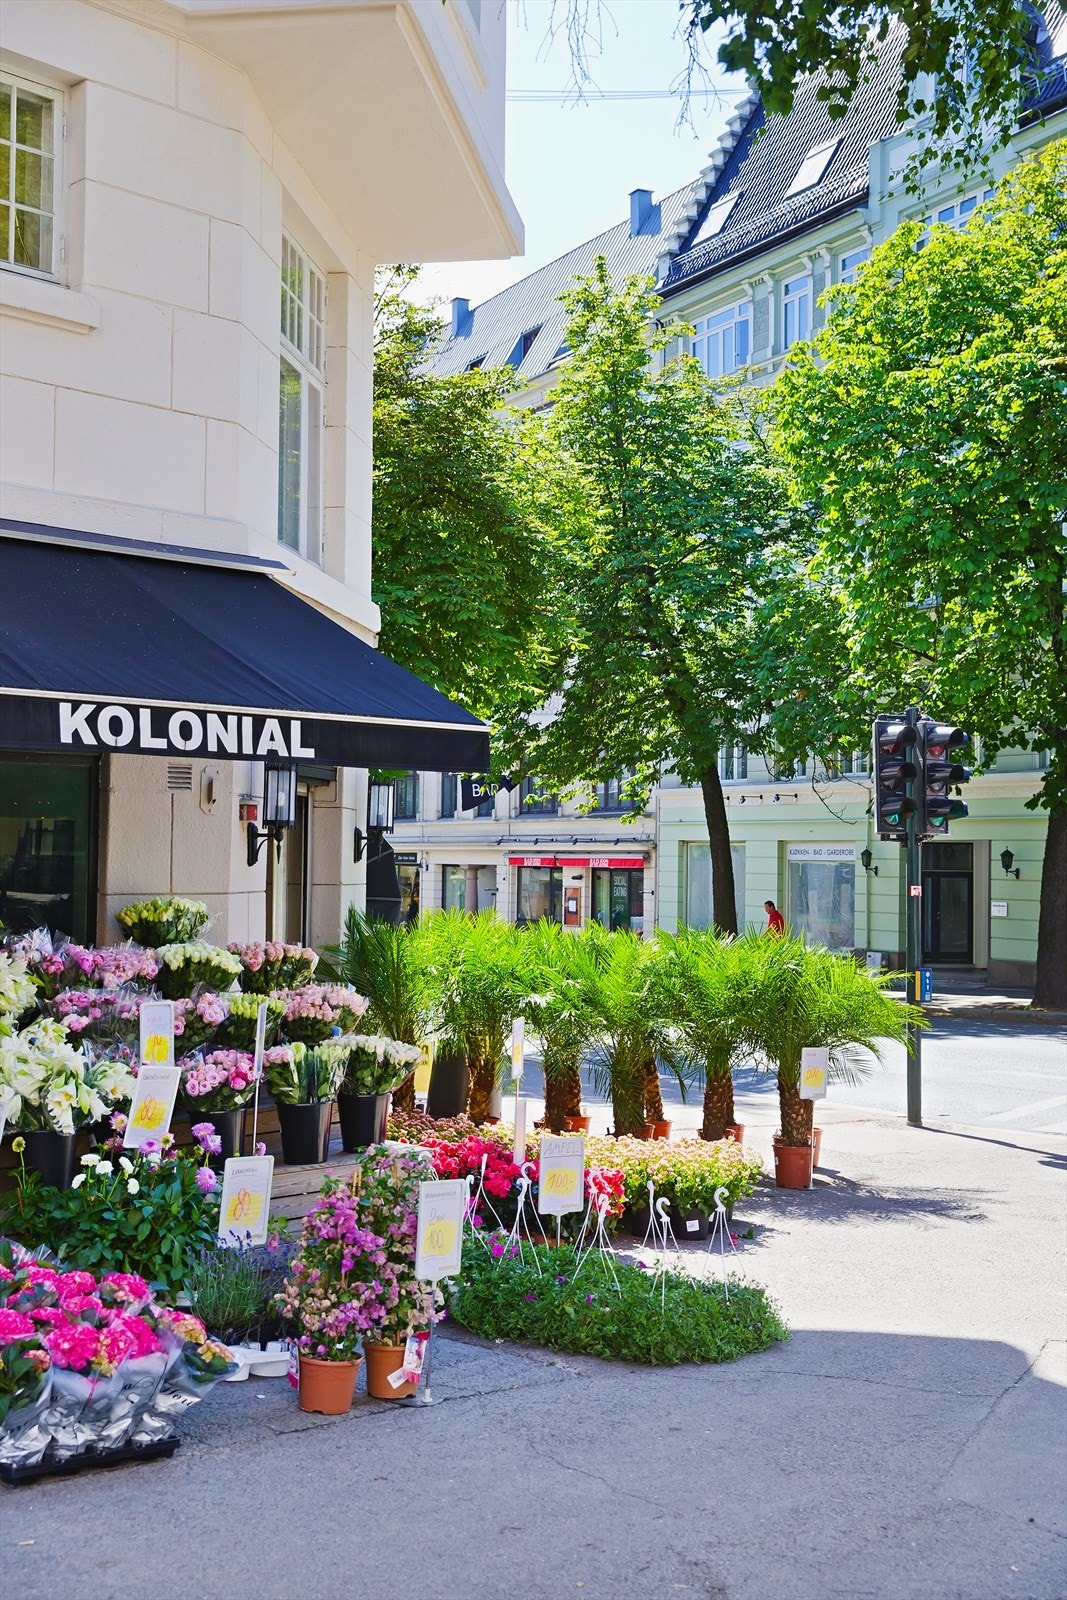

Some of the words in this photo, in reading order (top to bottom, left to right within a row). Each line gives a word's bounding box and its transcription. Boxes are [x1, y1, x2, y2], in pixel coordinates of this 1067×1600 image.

[58, 701, 316, 759] KOLONIAL
[471, 783, 499, 797] BAR
[789, 848, 810, 856] KJØKKEN
[813, 848, 823, 856] BAD
[826, 848, 854, 856] GARDEROBE
[613, 876, 627, 886] SOCIAL
[613, 886, 628, 897] EATING
[543, 1141, 579, 1156] AMPEL
[548, 1172, 574, 1192] 100,-
[233, 1187, 251, 1221] 80
[429, 1207, 437, 1226] 2
